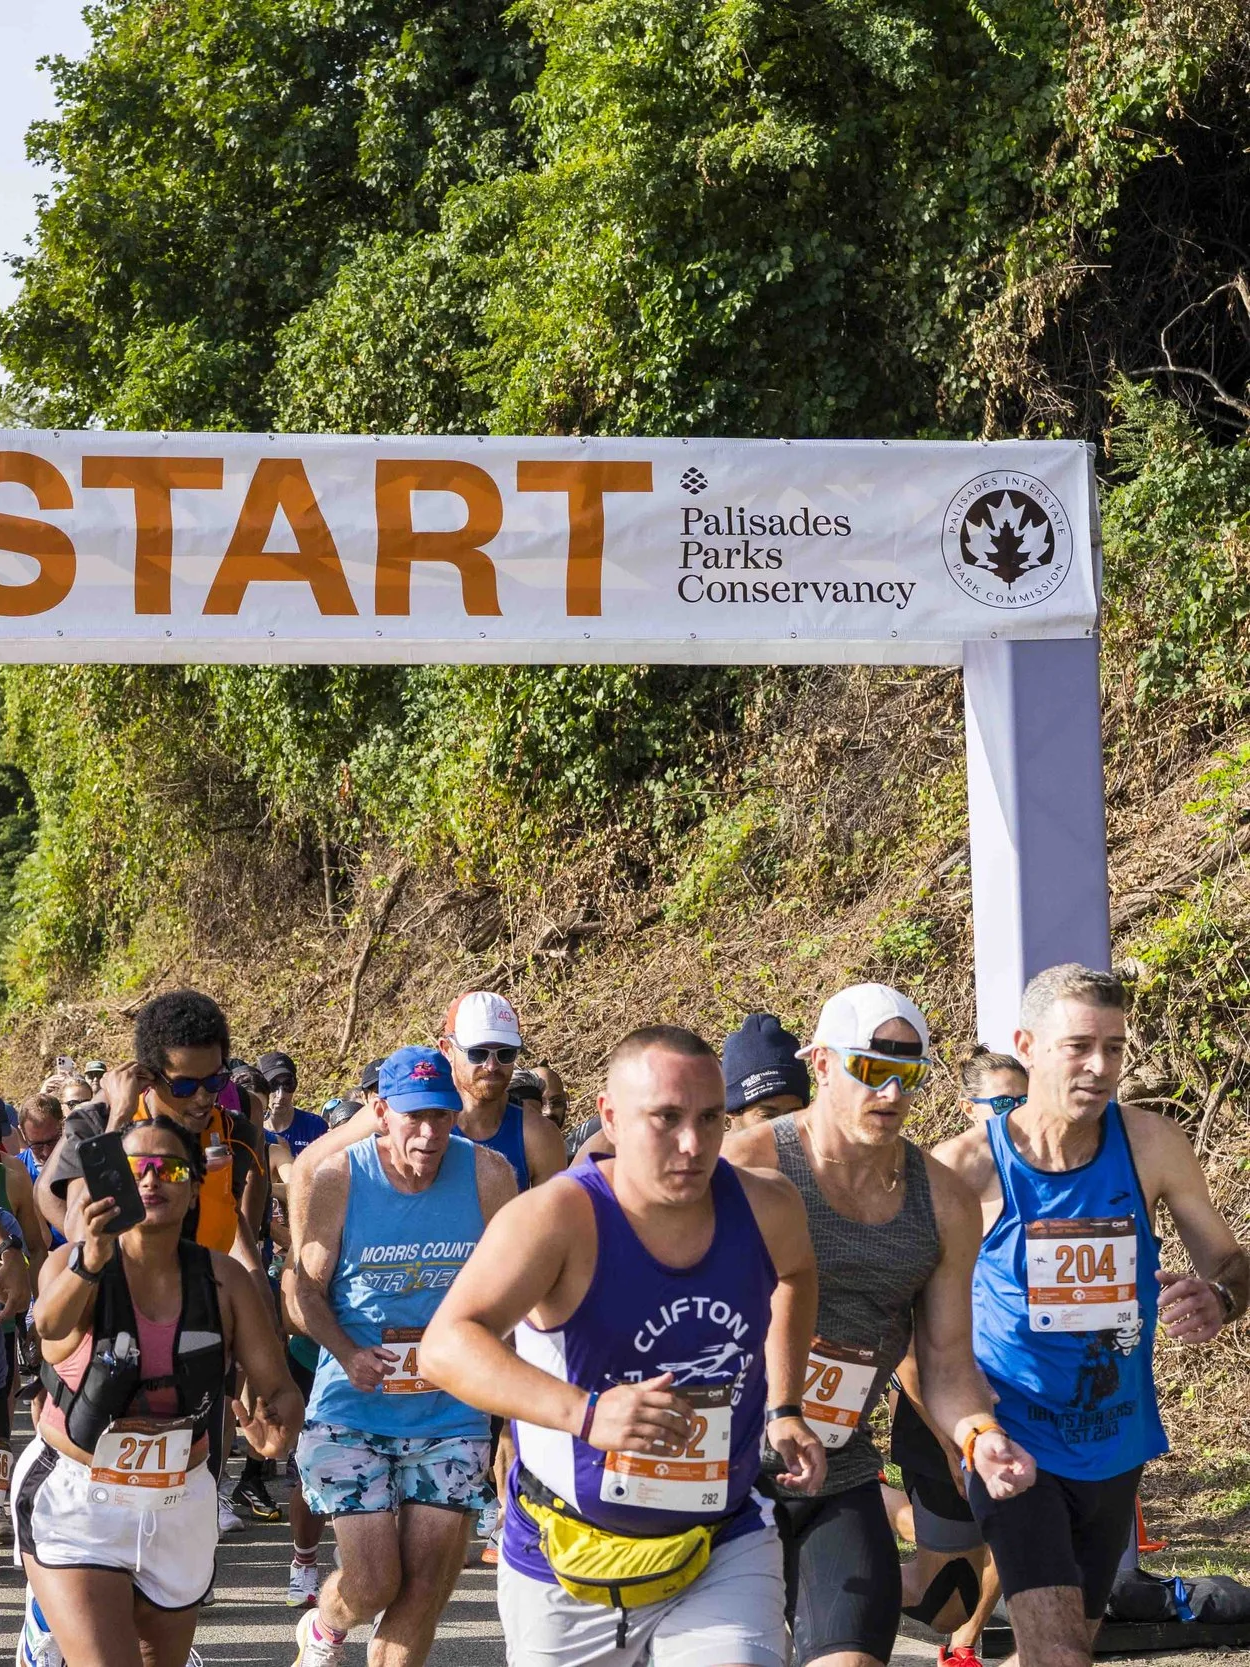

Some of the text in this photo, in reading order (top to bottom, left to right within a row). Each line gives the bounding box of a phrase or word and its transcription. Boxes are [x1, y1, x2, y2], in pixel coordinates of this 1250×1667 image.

[680, 506, 852, 537] Palisades
[949, 476, 1066, 536] PALISADES INTERSTATE
[679, 540, 783, 570] Parks
[677, 574, 917, 610] Conservancy
[953, 562, 1064, 604] PARK COMMISSION
[360, 1243, 420, 1262] MORRIS
[1055, 1243, 1117, 1284] 204
[634, 1296, 750, 1353] CLIFTON
[1117, 1311, 1131, 1324] 204
[116, 1436, 168, 1470] 271
[826, 1433, 839, 1444] 79
[163, 1495, 177, 1505] 271
[701, 1492, 719, 1506] 282
